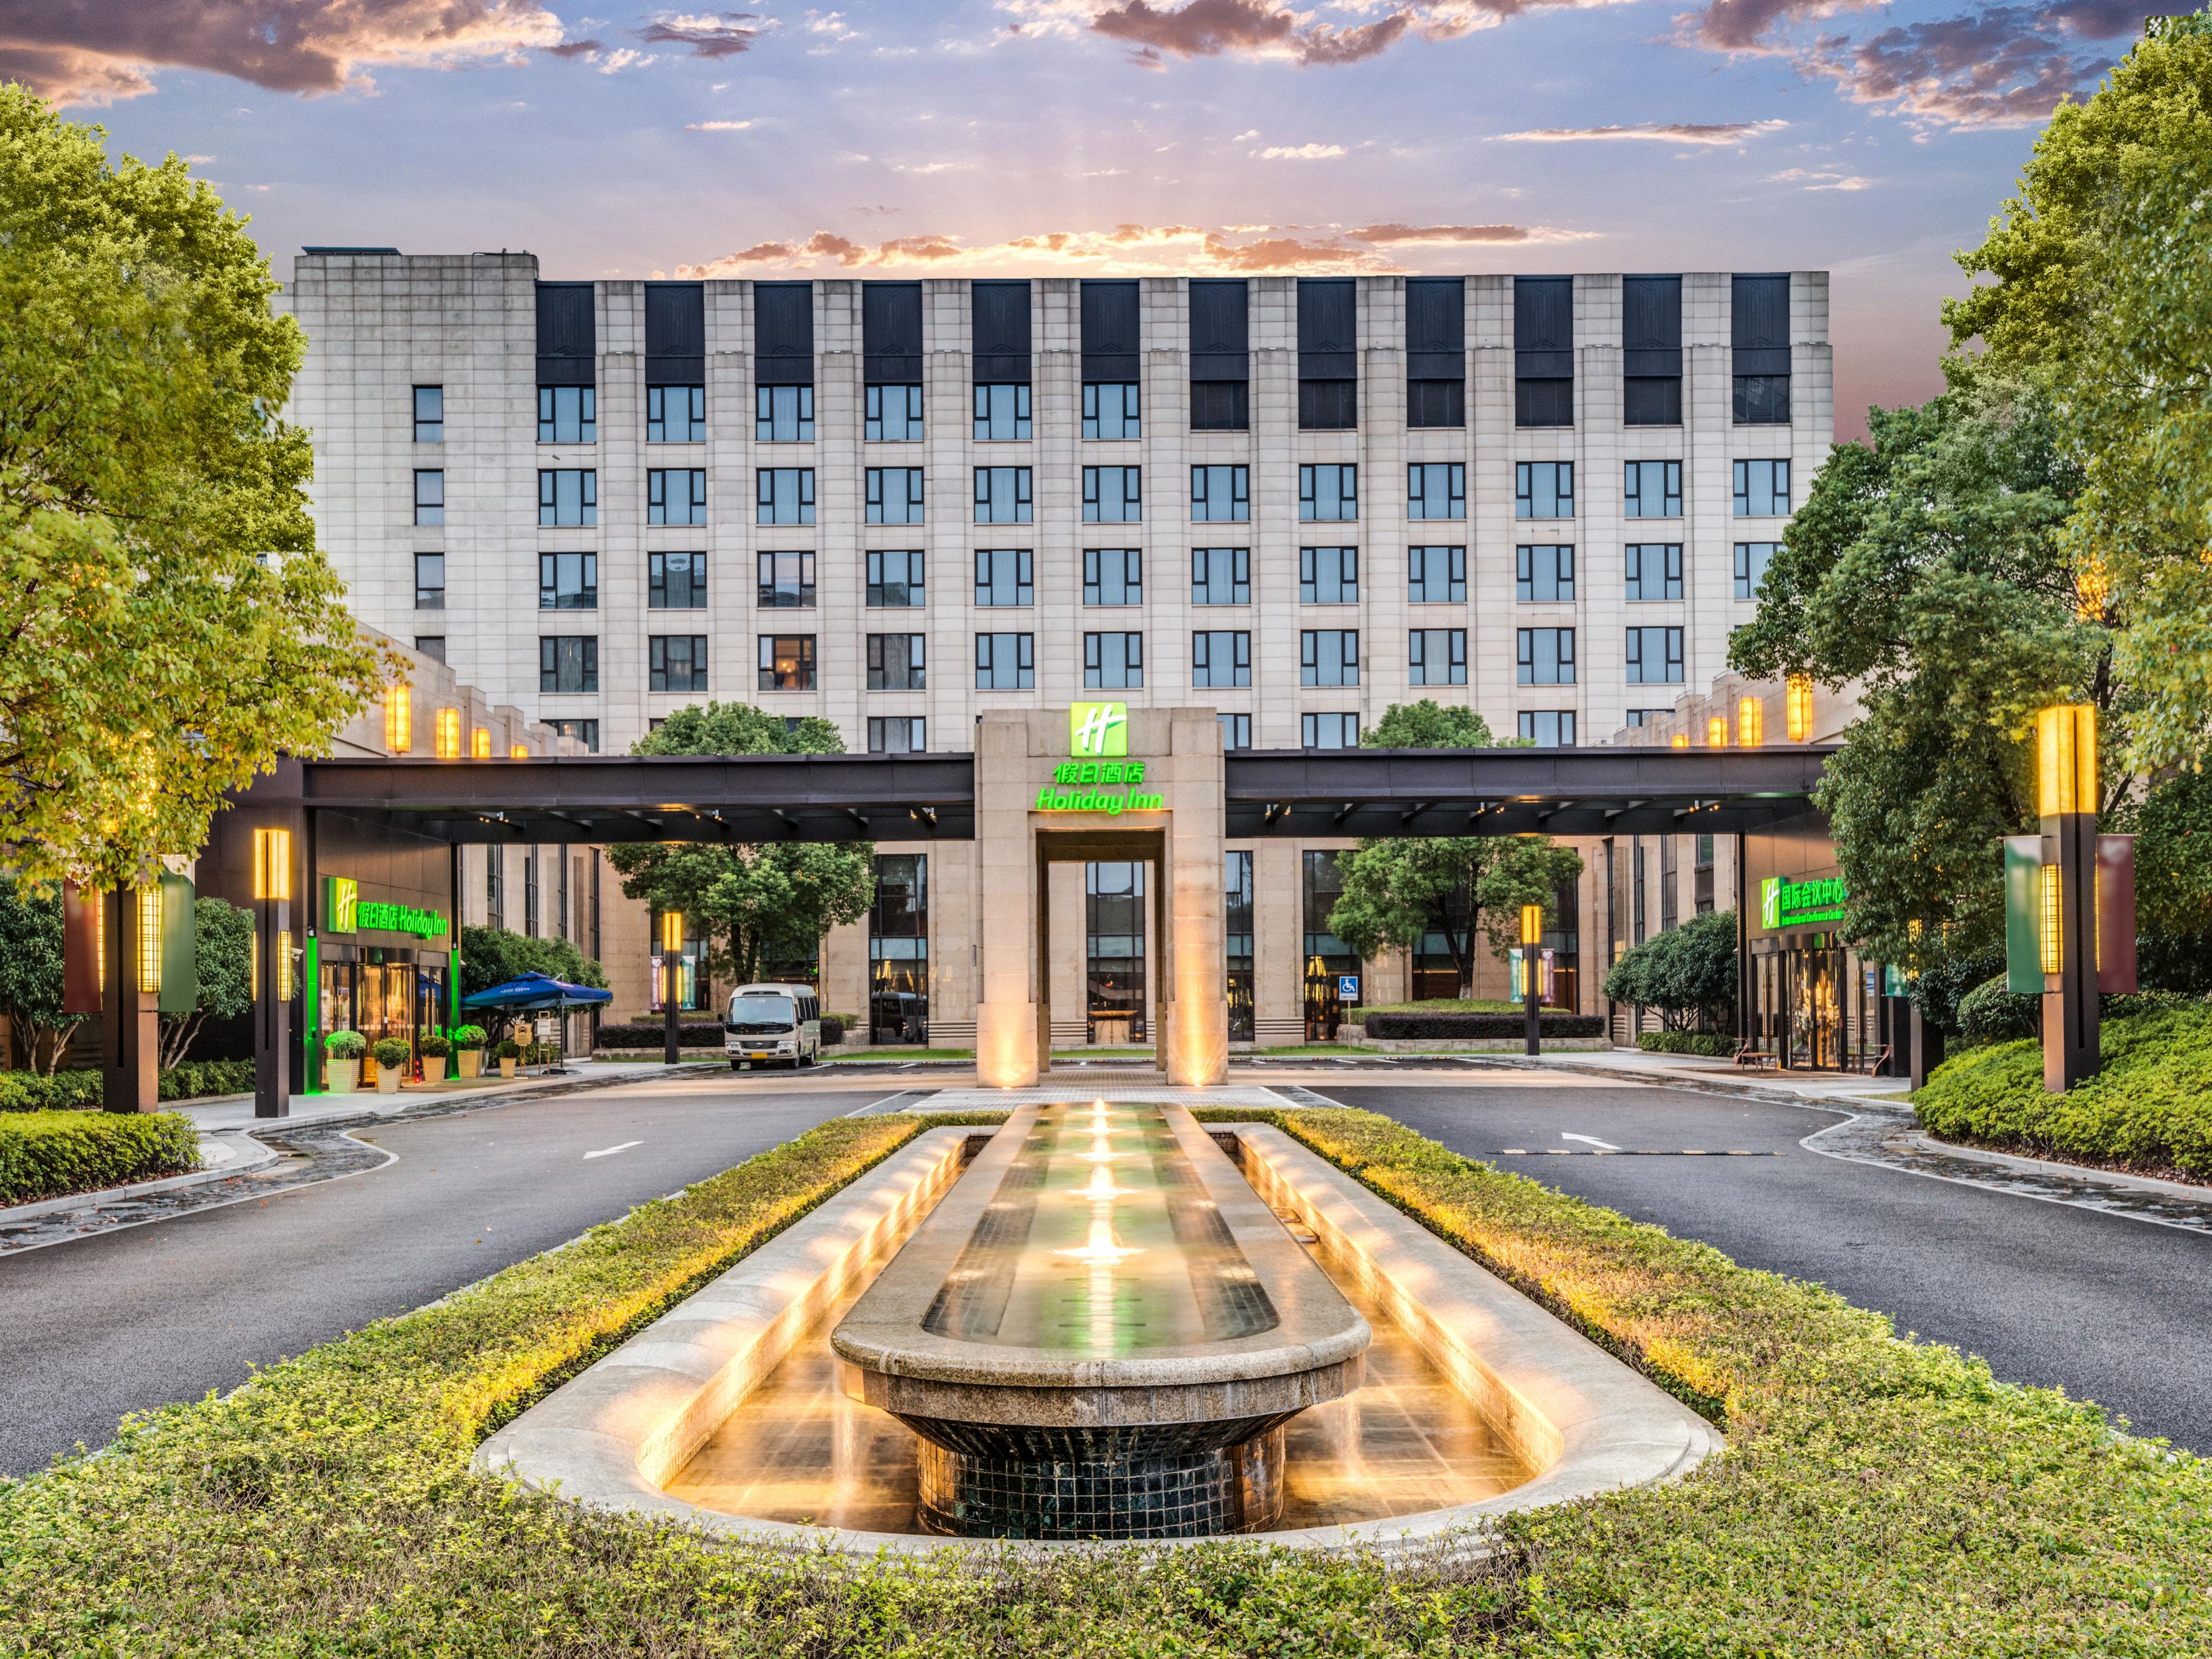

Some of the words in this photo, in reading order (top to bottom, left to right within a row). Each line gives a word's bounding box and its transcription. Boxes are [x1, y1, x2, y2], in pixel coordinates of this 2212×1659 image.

[1053, 763, 1145, 784] 假日酒店
[1036, 787, 1124, 815] Holiday
[1128, 787, 1164, 810] Inn
[1782, 877, 1843, 911] 国际会议中心
[358, 902, 397, 930] 假日酒店
[399, 905, 433, 940] Holiday
[434, 910, 447, 935] Inn
